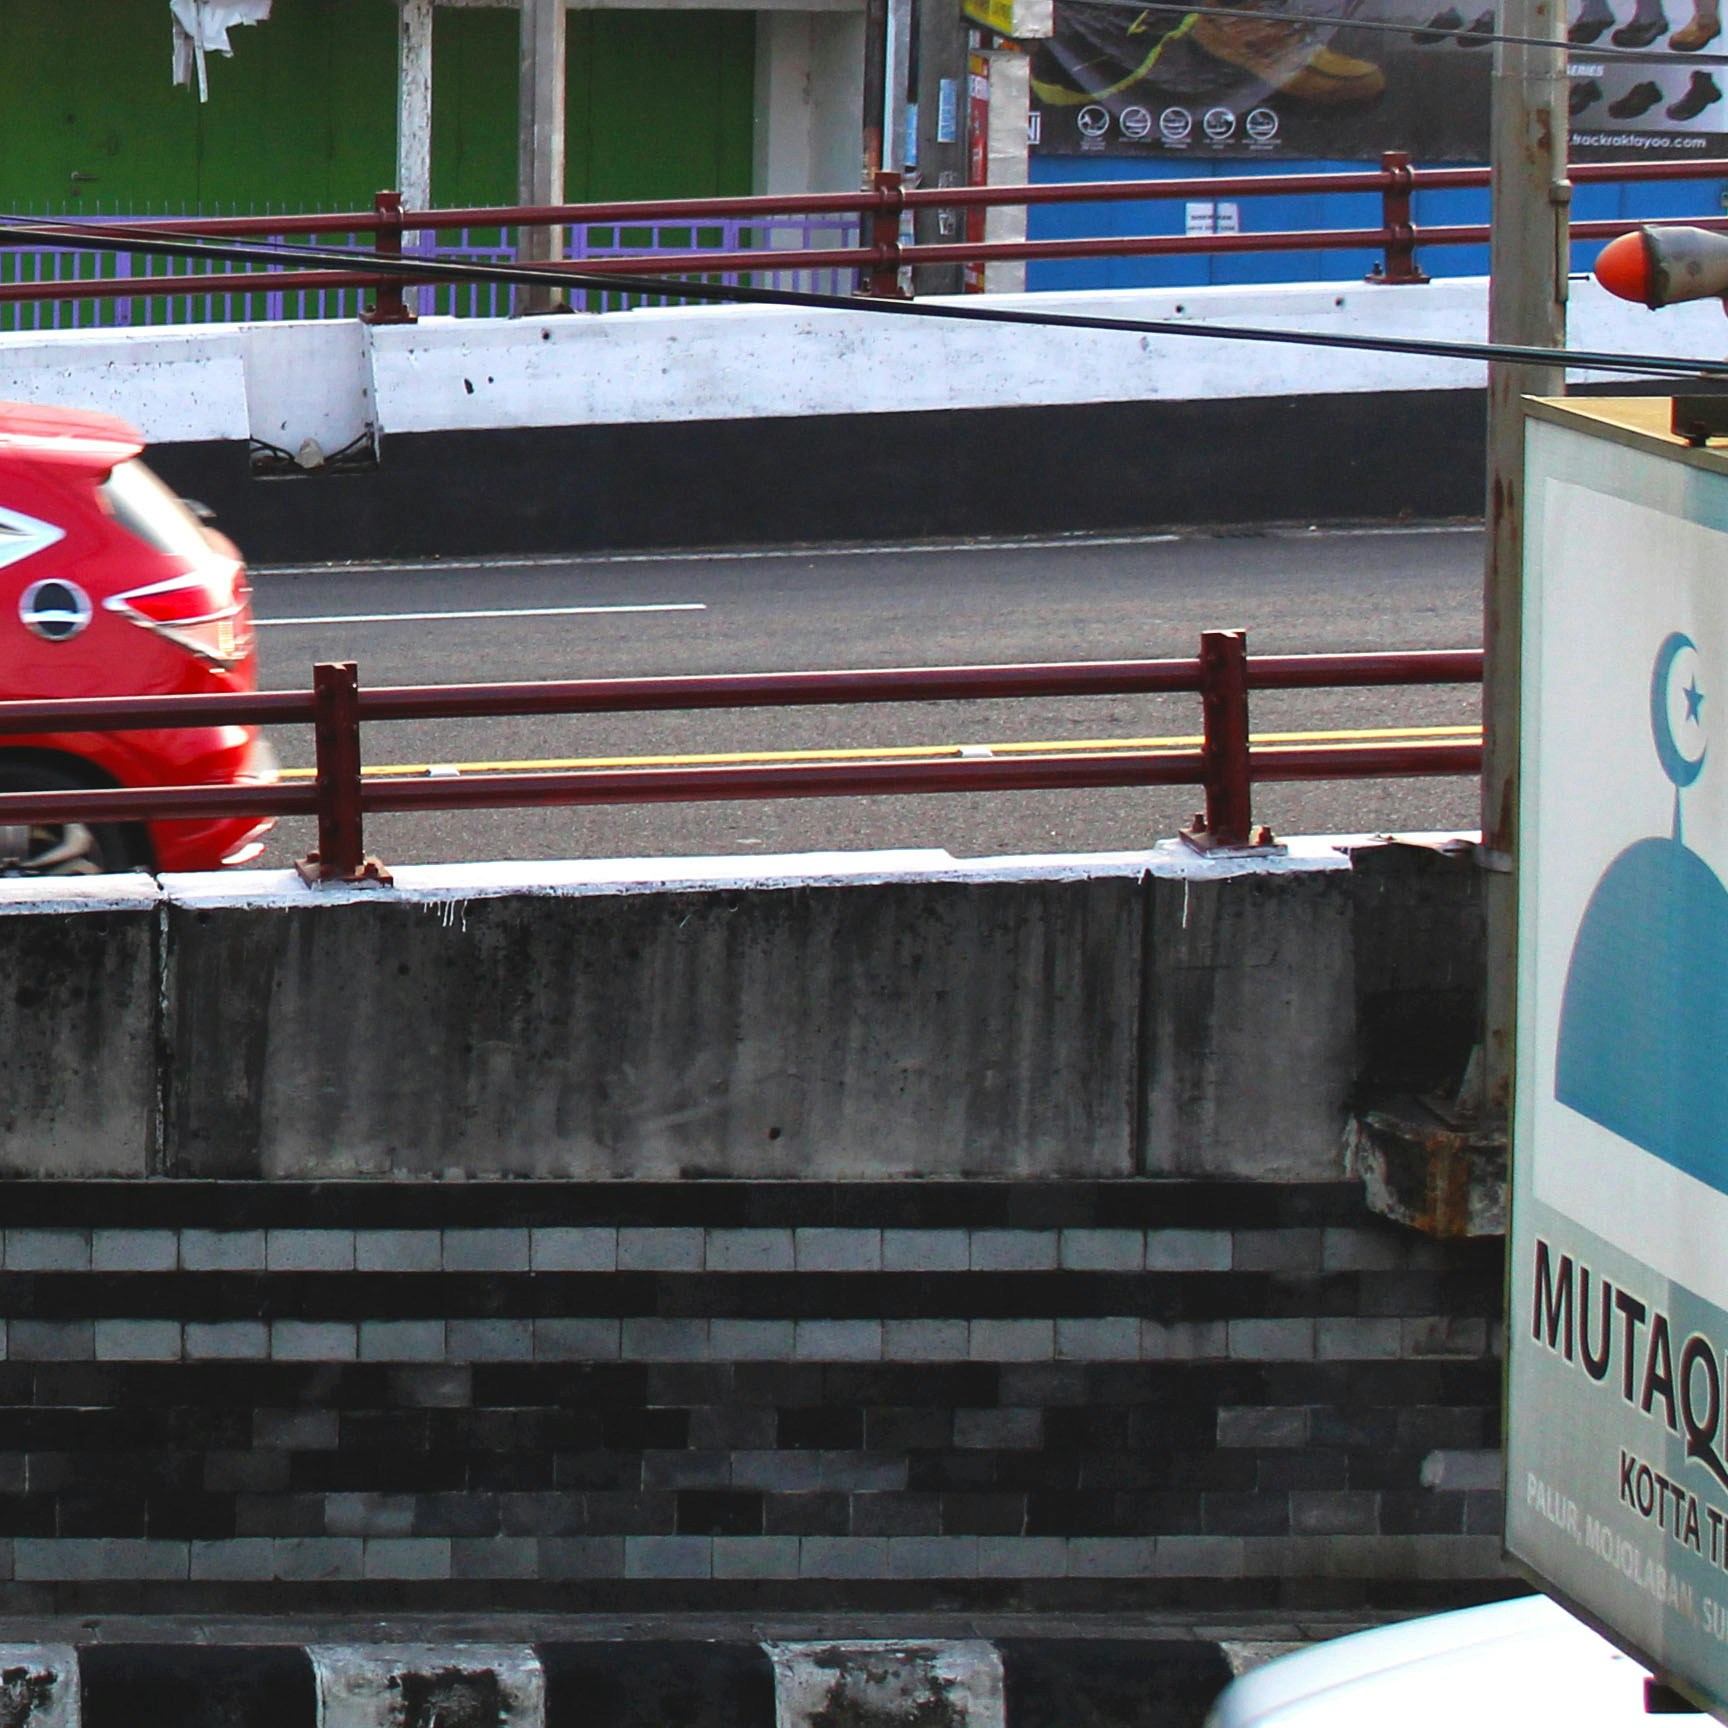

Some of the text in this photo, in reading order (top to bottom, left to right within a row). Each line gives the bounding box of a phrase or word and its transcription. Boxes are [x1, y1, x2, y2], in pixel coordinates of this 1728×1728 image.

[1531, 1238, 1728, 1494] MUTAQ
[1619, 1448, 1703, 1557] KOTTA
[1701, 1595, 1728, 1643] SU
